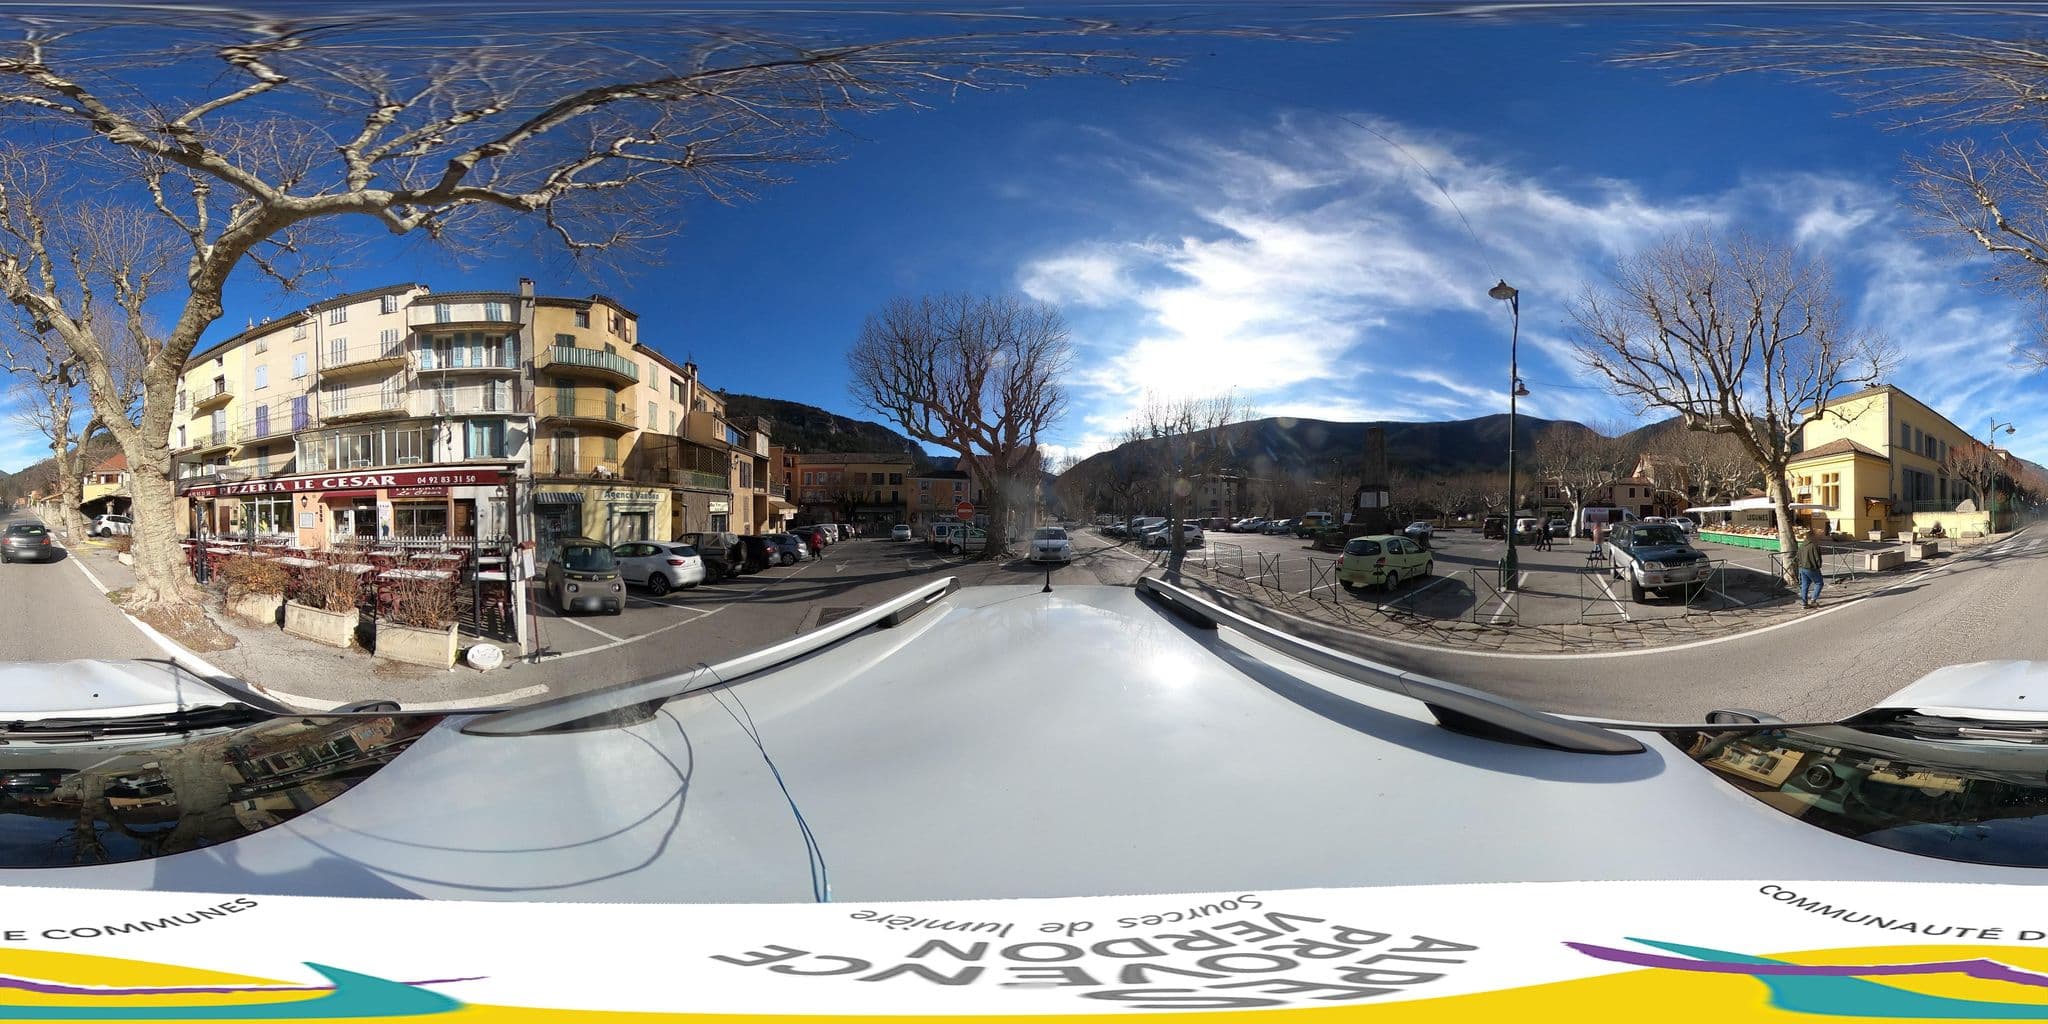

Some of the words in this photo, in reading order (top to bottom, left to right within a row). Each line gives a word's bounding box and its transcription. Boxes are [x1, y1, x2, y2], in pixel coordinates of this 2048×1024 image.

[429, 476, 438, 484] 92
[453, 475, 462, 483] 31
[219, 482, 286, 496] PIZZERIA
[294, 480, 315, 490] LE
[321, 475, 396, 488] CESAR
[604, 489, 634, 499] Agence
